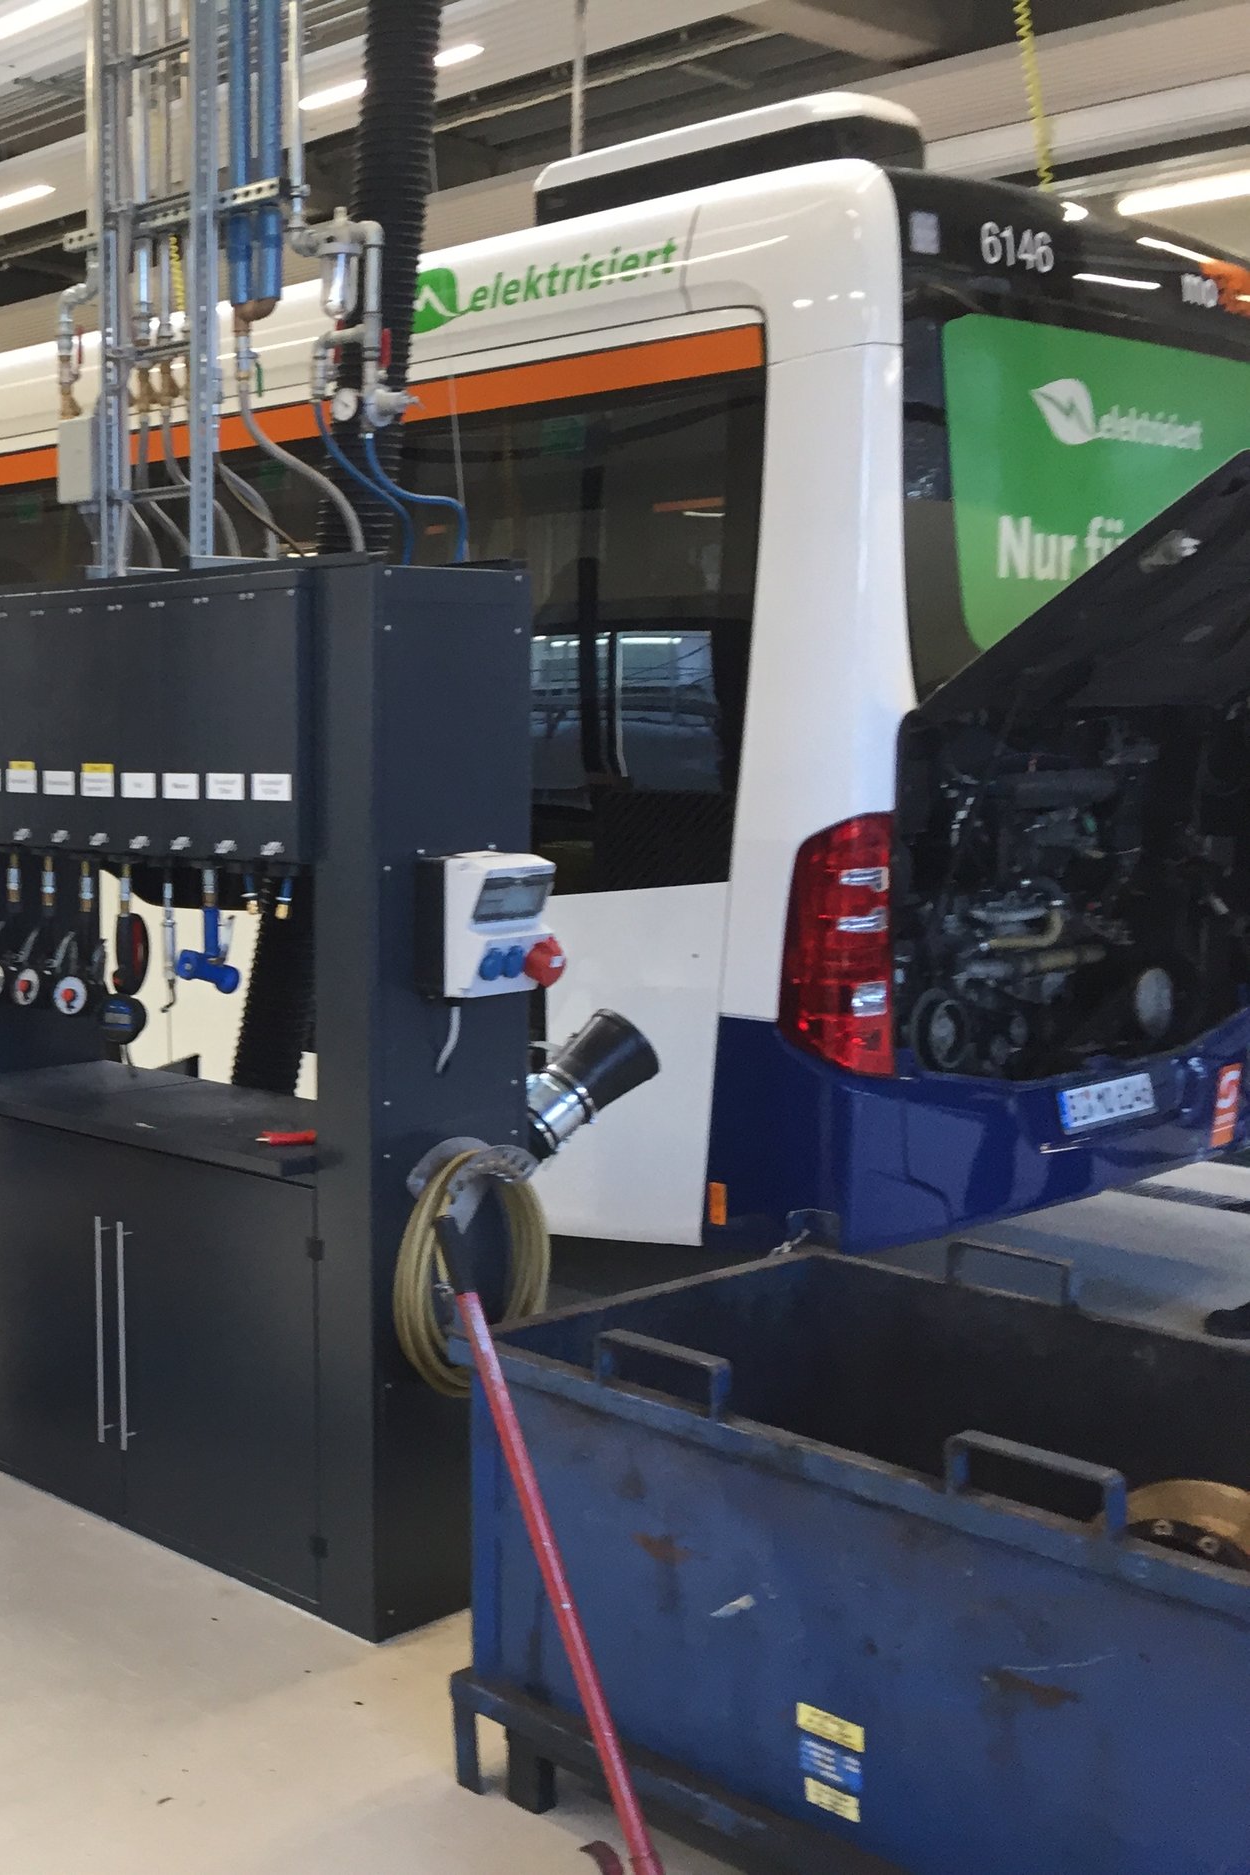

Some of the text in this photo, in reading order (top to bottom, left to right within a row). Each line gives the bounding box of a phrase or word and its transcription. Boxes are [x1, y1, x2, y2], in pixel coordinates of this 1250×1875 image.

[469, 237, 678, 313] elektrisiert
[980, 220, 1055, 273] 6146
[998, 515, 1077, 580] Nur
